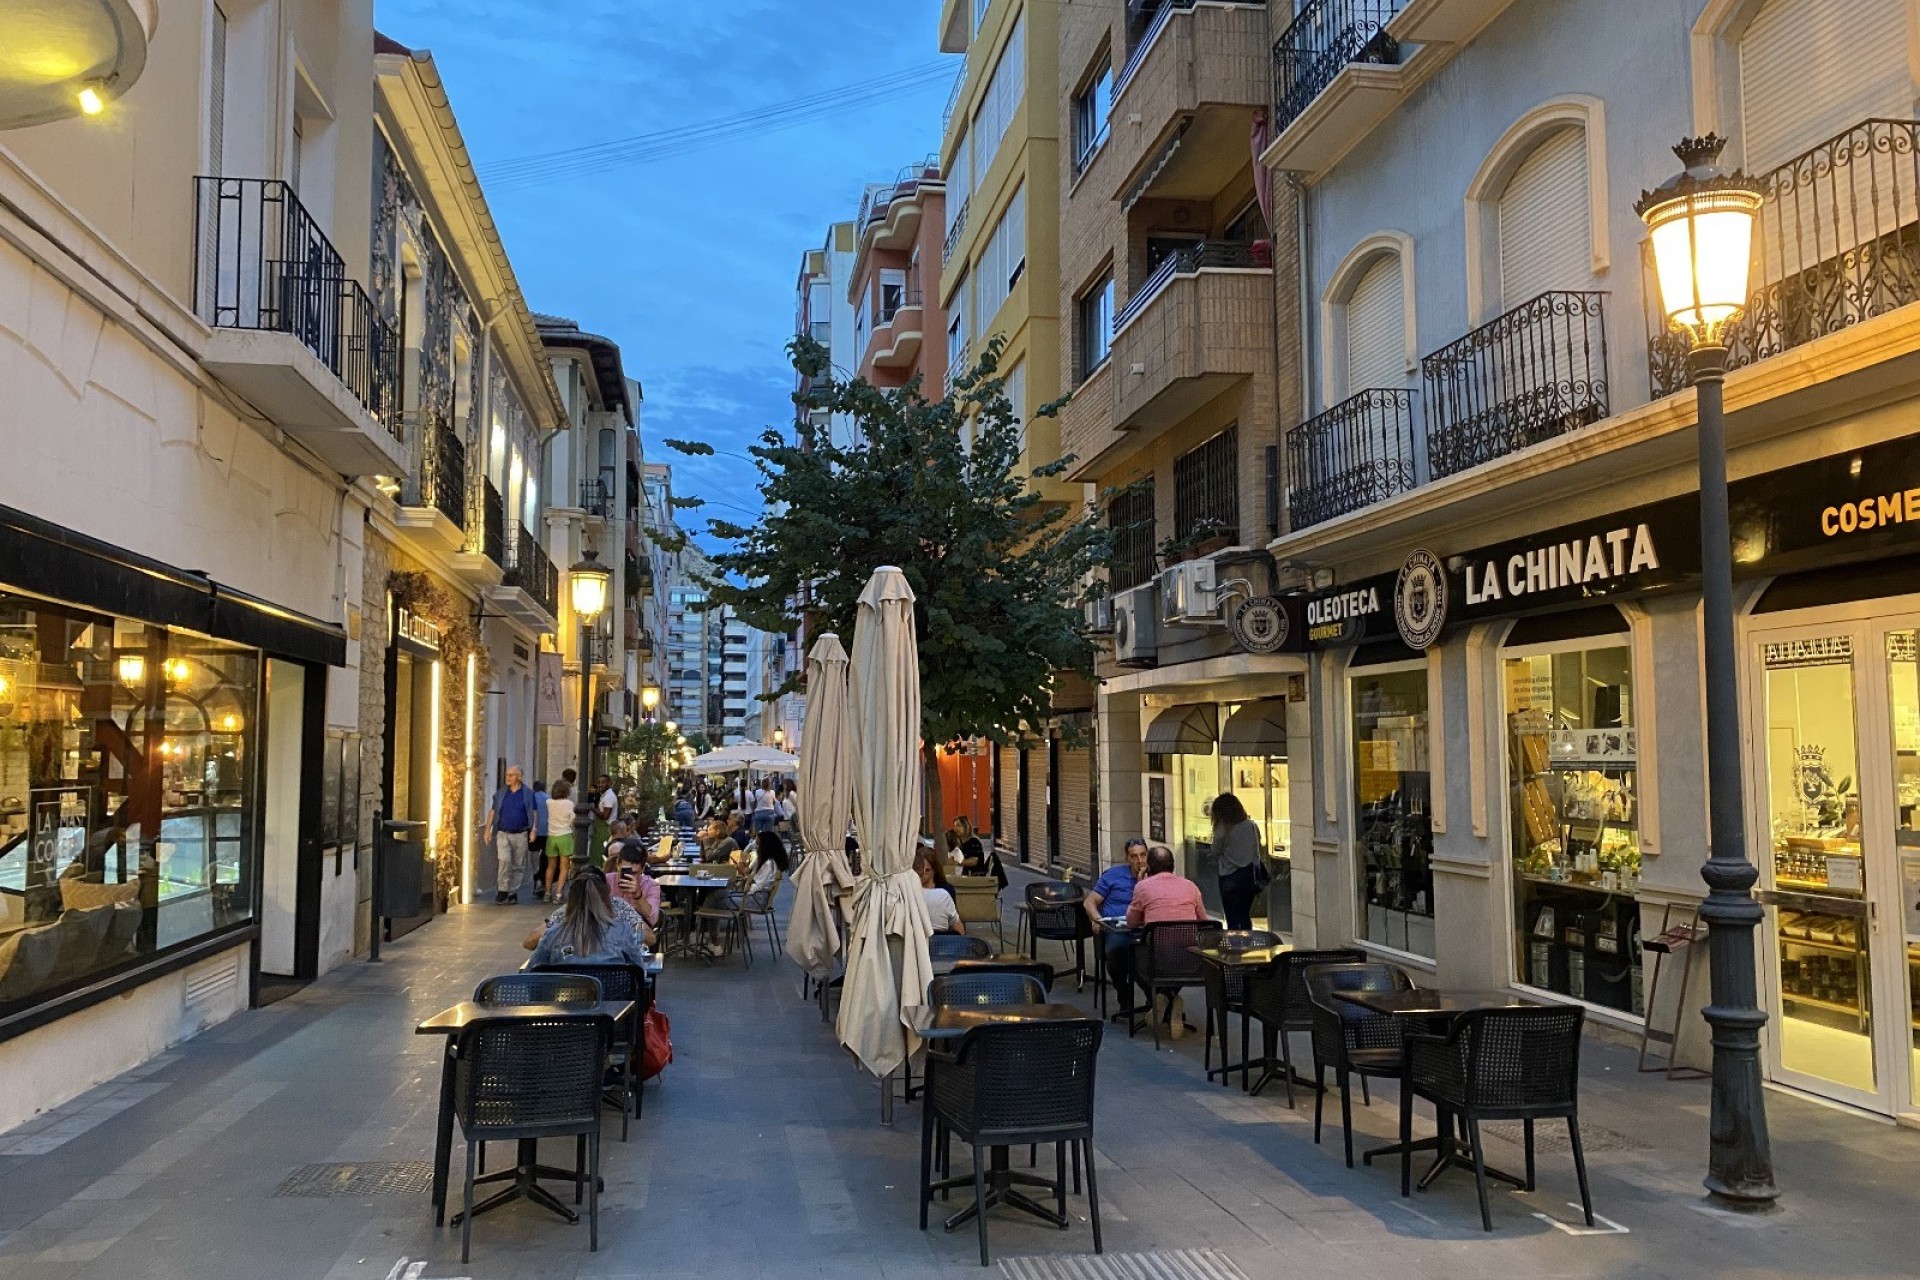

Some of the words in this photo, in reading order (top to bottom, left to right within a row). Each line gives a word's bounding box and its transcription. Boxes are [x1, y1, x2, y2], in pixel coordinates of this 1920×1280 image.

[1822, 487, 1920, 537] COSME
[1466, 560, 1502, 605] LA
[1507, 523, 1660, 597] CHINATA
[1307, 587, 1379, 625] OLEOTECA
[1308, 622, 1343, 641] GOURMET
